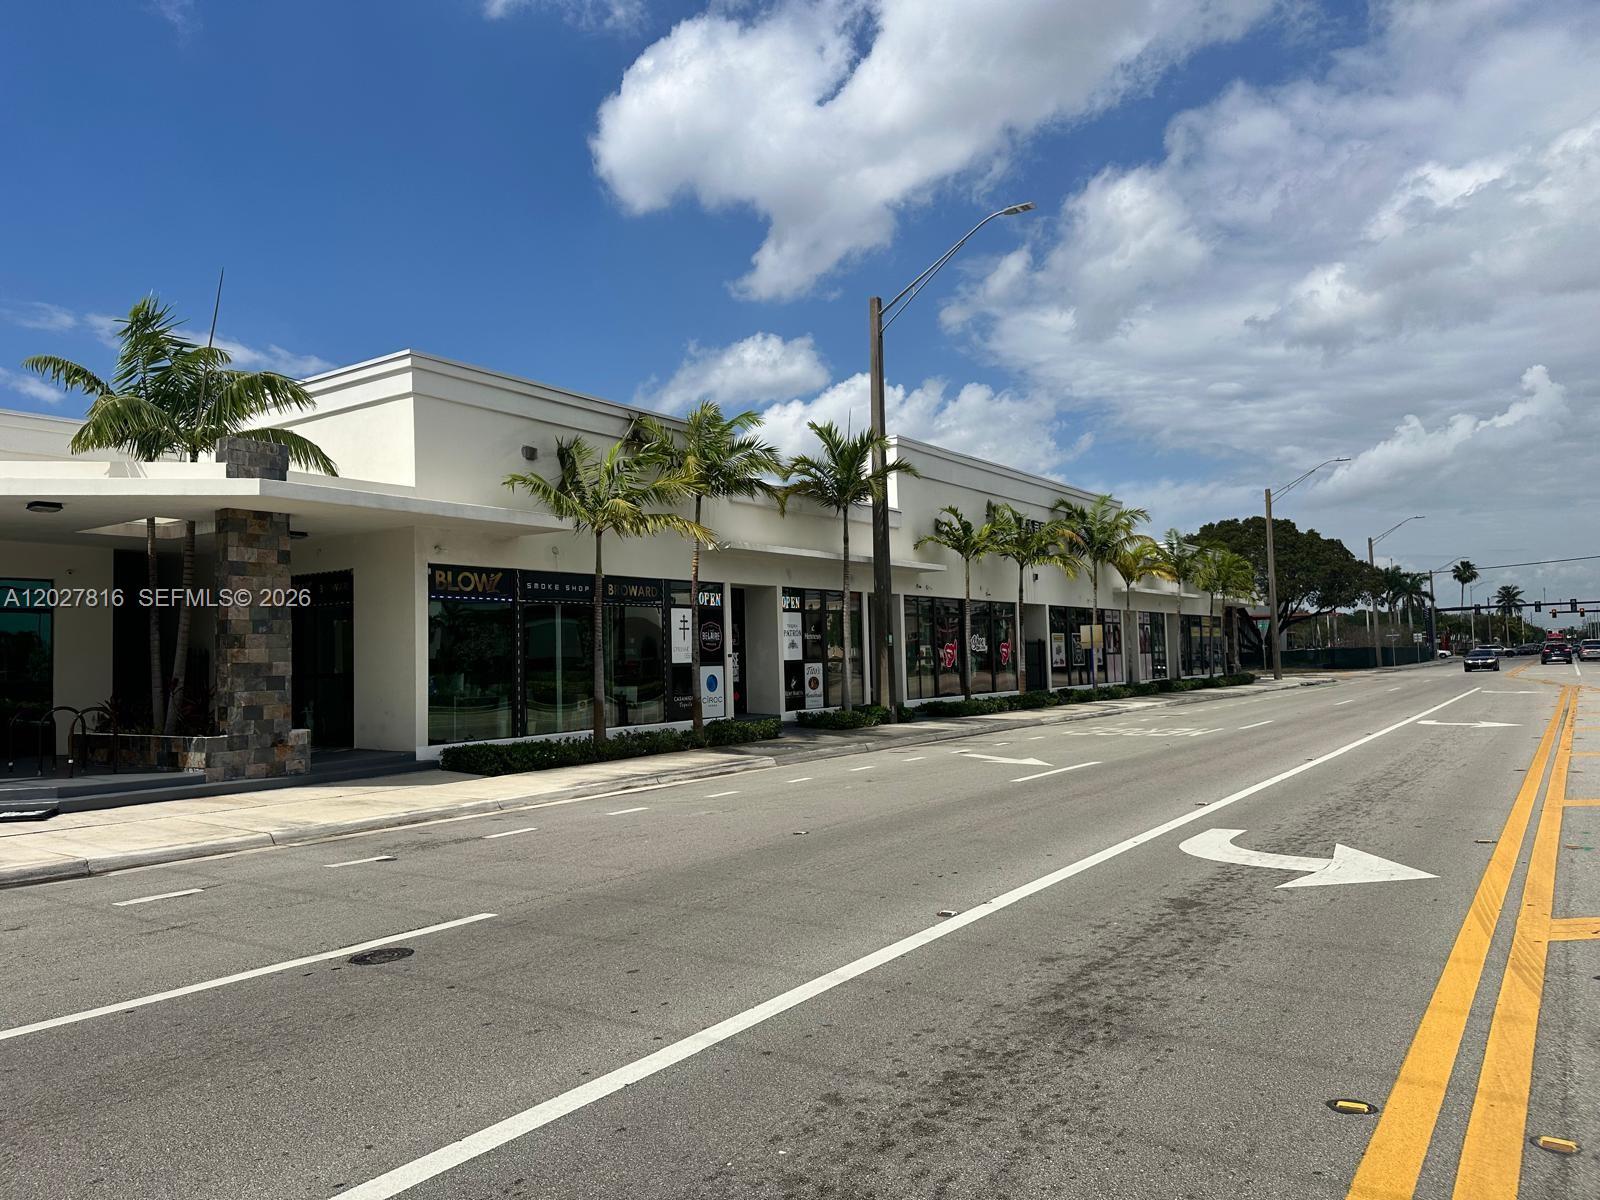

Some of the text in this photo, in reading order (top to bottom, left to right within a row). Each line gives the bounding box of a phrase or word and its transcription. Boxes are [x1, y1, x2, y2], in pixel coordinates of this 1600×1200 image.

[527, 583, 590, 592] SMOKE SHOP
[698, 591, 722, 607] OPEN
[782, 596, 801, 609] OPEN
